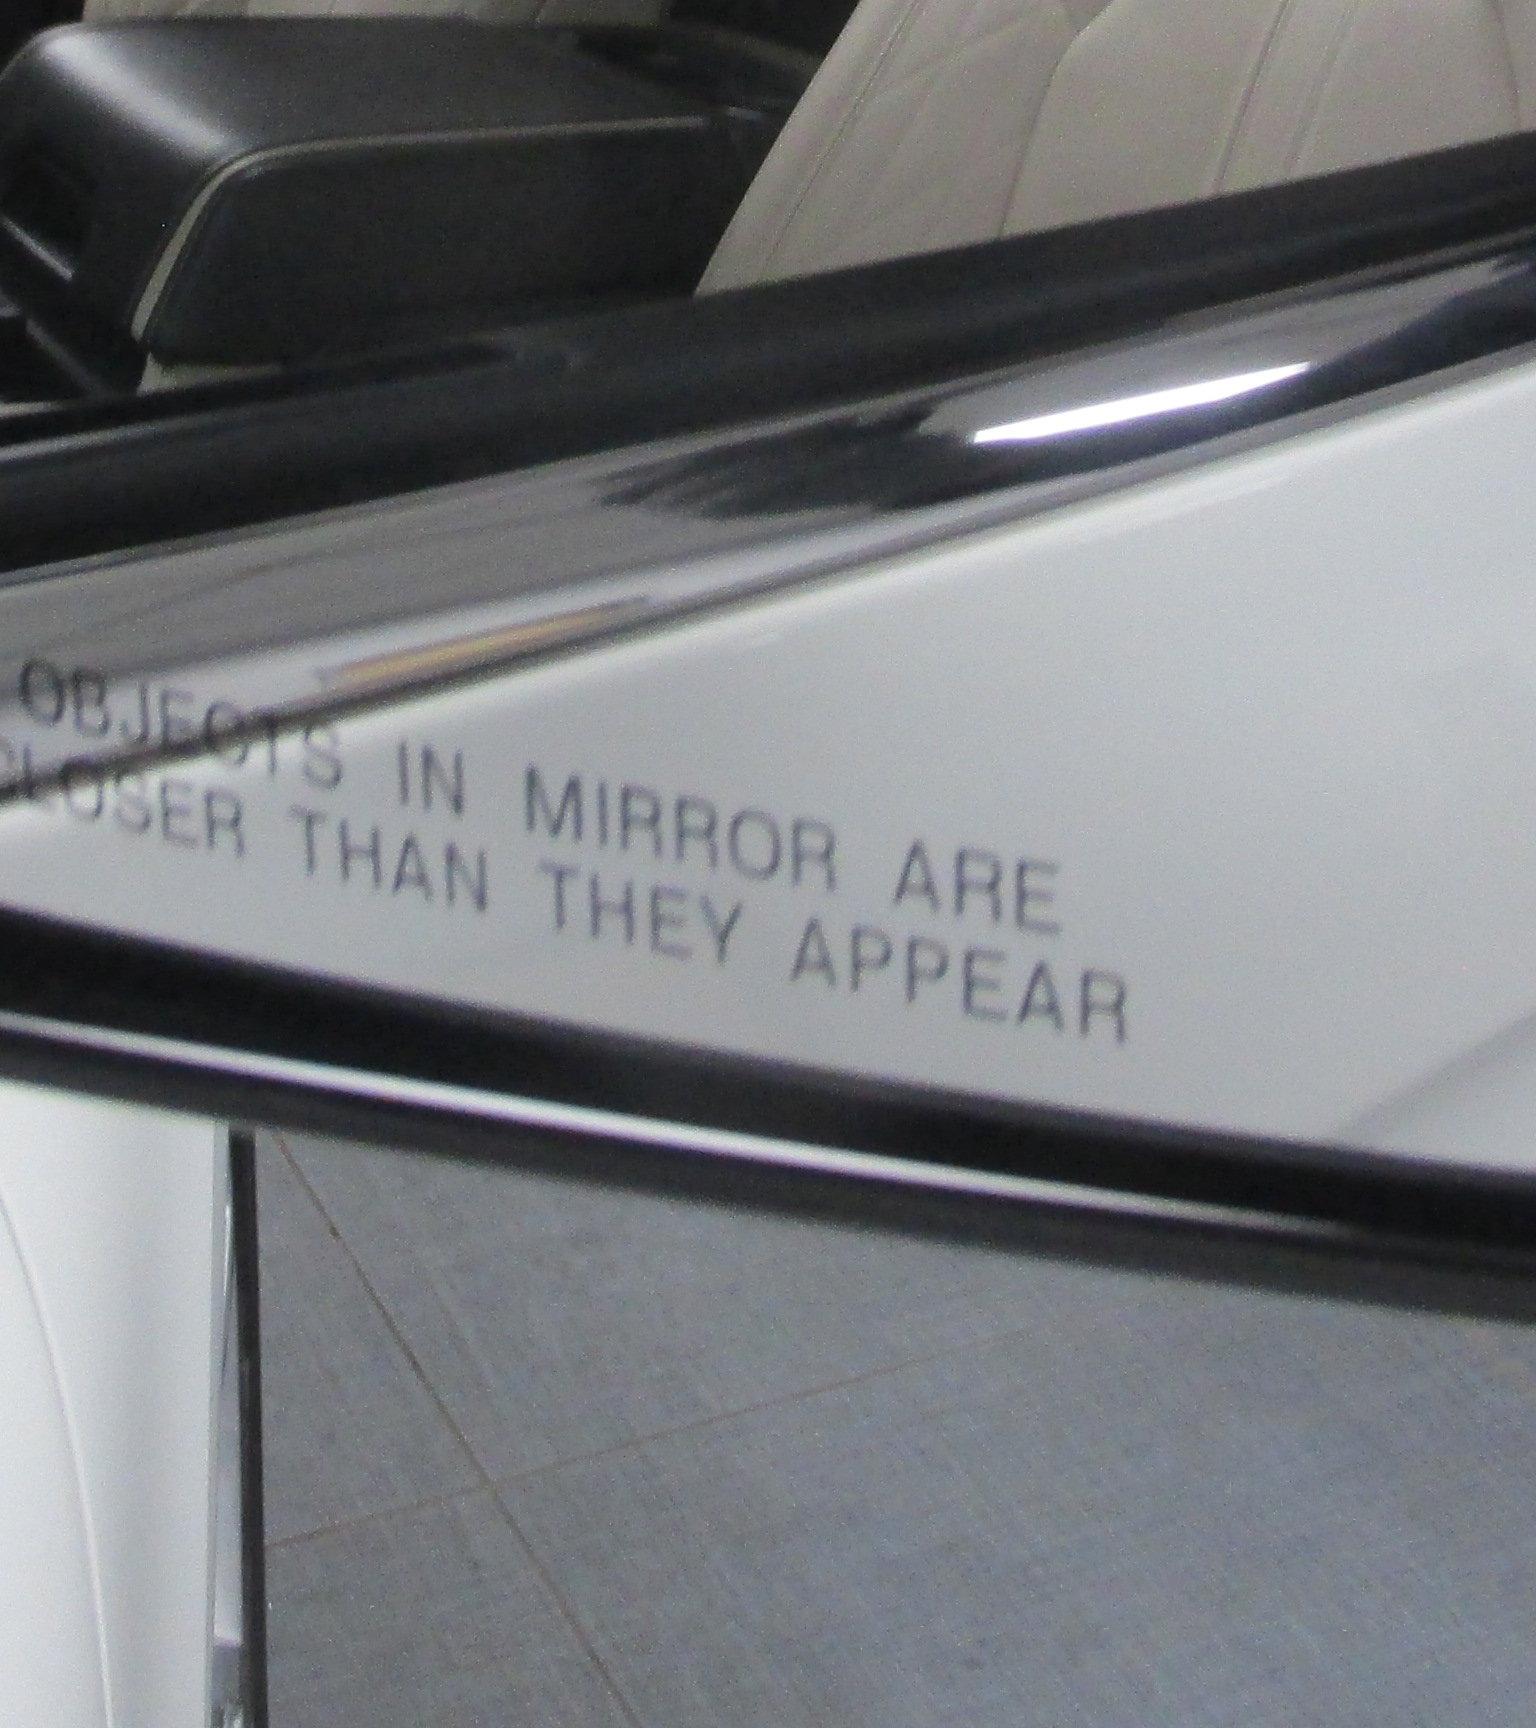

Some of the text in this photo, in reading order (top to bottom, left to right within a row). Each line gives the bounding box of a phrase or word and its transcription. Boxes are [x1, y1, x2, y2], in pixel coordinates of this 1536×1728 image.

[18, 657, 1063, 936] OBJECTS IN MIRROR ARE
[287, 803, 488, 915] THAN
[537, 856, 744, 966] THEY
[788, 915, 1129, 1047] APPEAR
